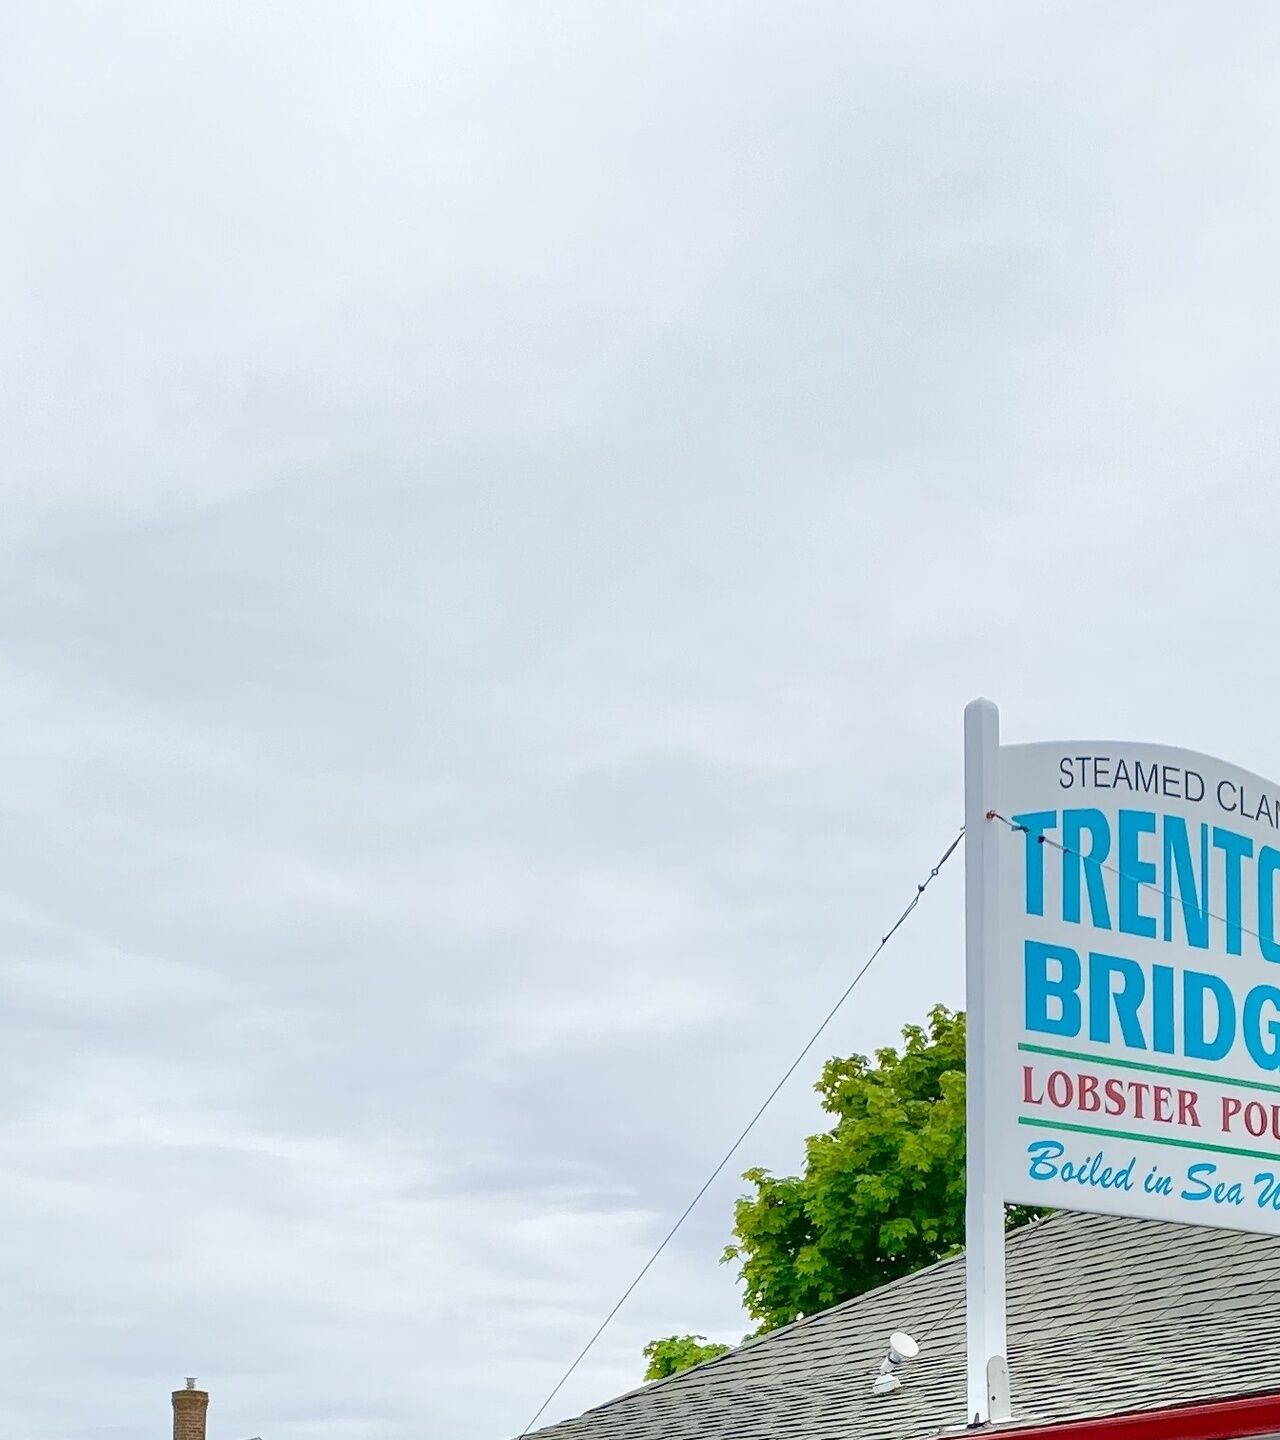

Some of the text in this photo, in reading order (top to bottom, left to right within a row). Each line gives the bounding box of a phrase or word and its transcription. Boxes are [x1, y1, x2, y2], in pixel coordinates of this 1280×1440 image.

[1059, 757, 1205, 803] STEAMED
[1022, 1066, 1201, 1127] LOBSTER
[1026, 1140, 1137, 1193] Boiled
[1143, 1166, 1174, 1197] in
[1180, 1163, 1245, 1206] Sea
